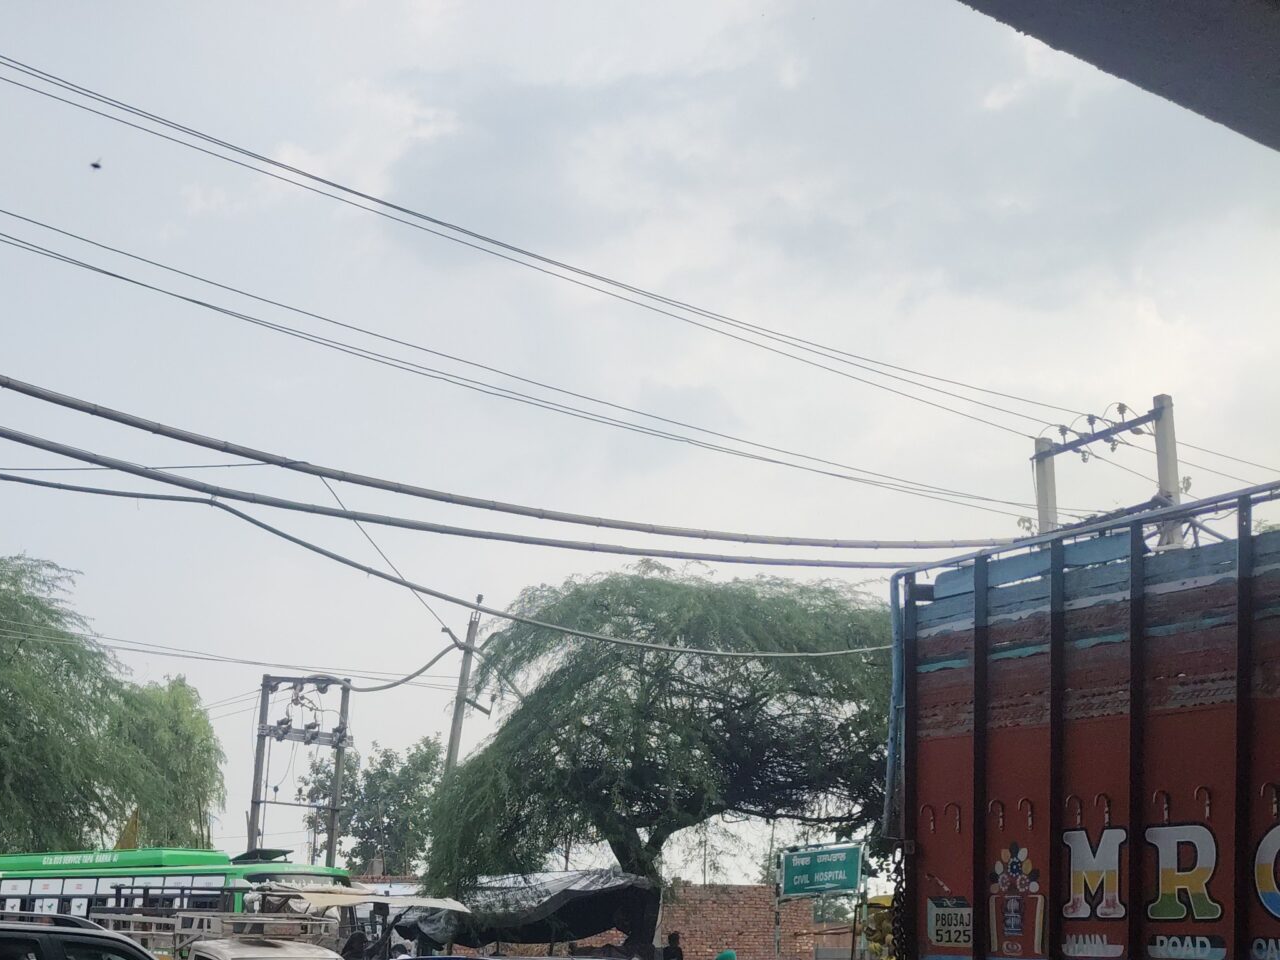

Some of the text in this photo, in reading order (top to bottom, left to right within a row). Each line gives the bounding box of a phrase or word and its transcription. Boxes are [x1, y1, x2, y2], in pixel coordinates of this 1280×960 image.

[793, 870, 847, 885] CIVIL HOSPITAL
[1062, 827, 1127, 919] M
[1144, 825, 1221, 920] R
[935, 912, 971, 927] PB03AJ
[935, 928, 972, 943] 5125
[1156, 935, 1211, 957] ROAD
